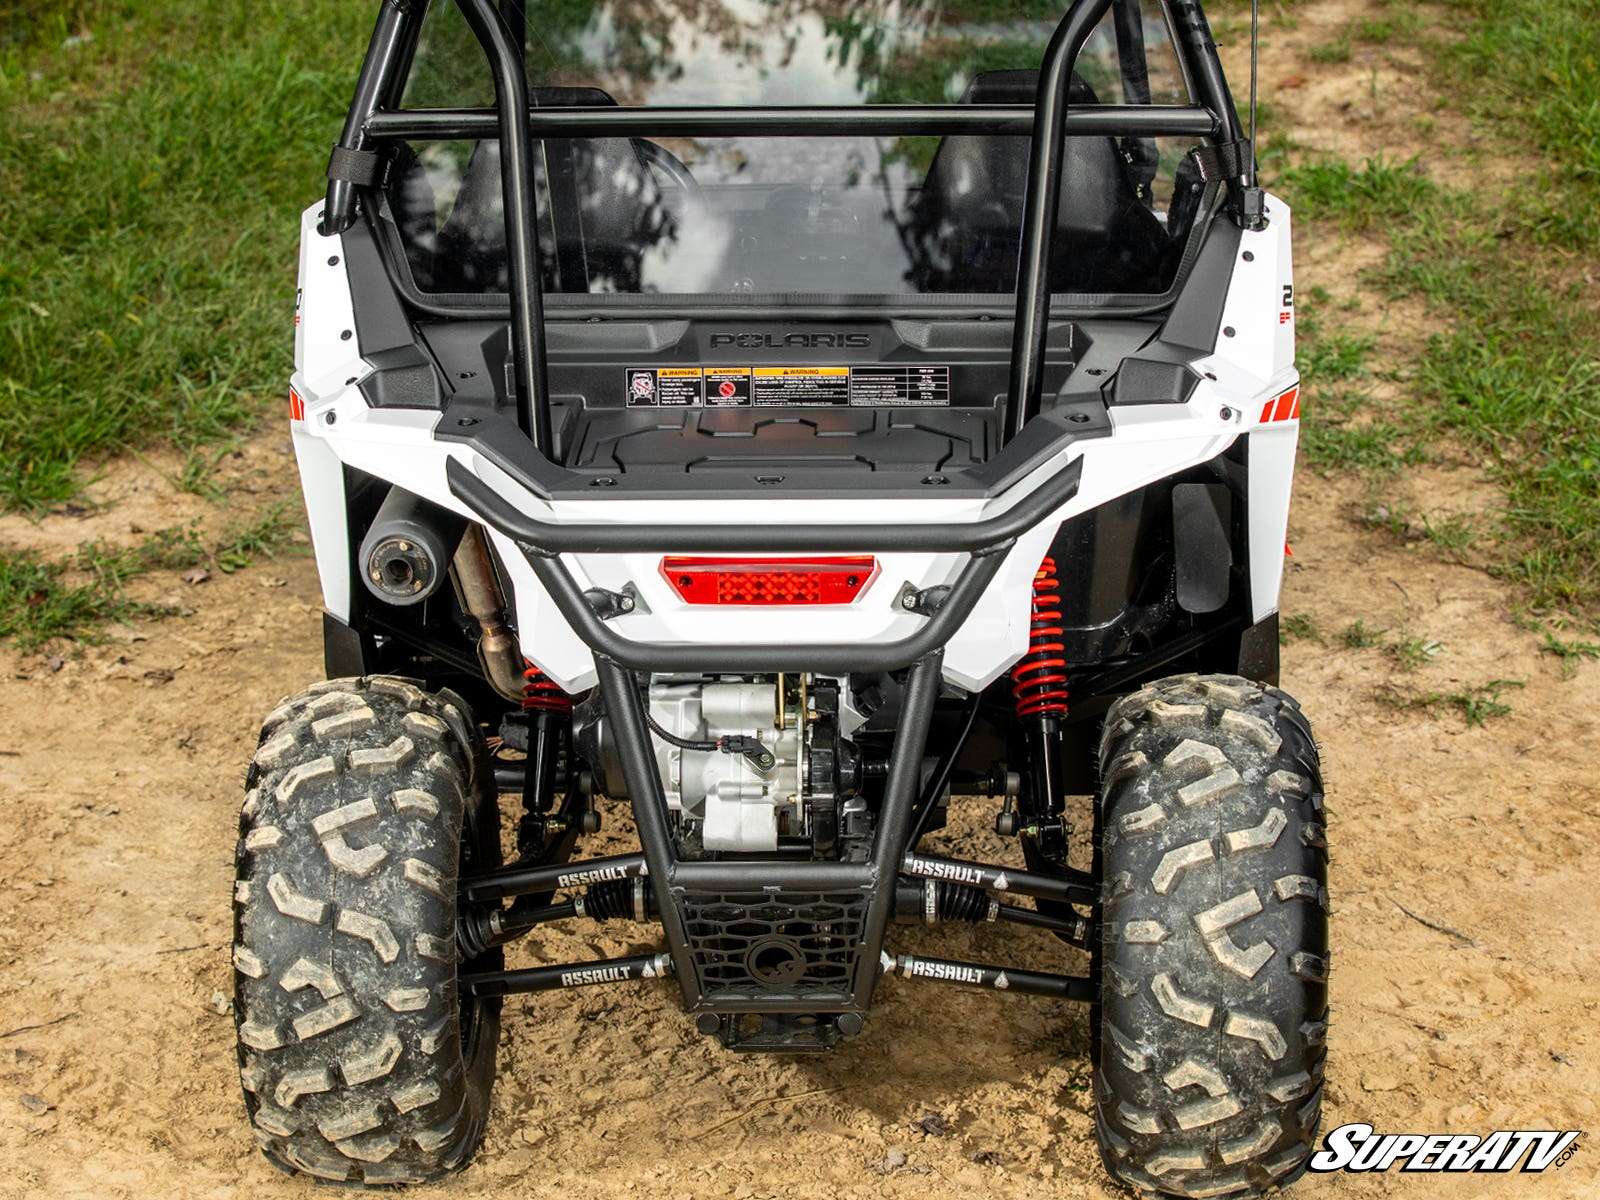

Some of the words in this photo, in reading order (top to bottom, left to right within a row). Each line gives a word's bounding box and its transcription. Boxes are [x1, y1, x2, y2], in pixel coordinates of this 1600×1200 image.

[710, 333, 872, 349] POLARIS
[558, 866, 628, 888] ASSAULT
[912, 859, 985, 884] ASSAULT
[561, 966, 631, 986] ASSAULT
[912, 961, 985, 984] ASSAULT
